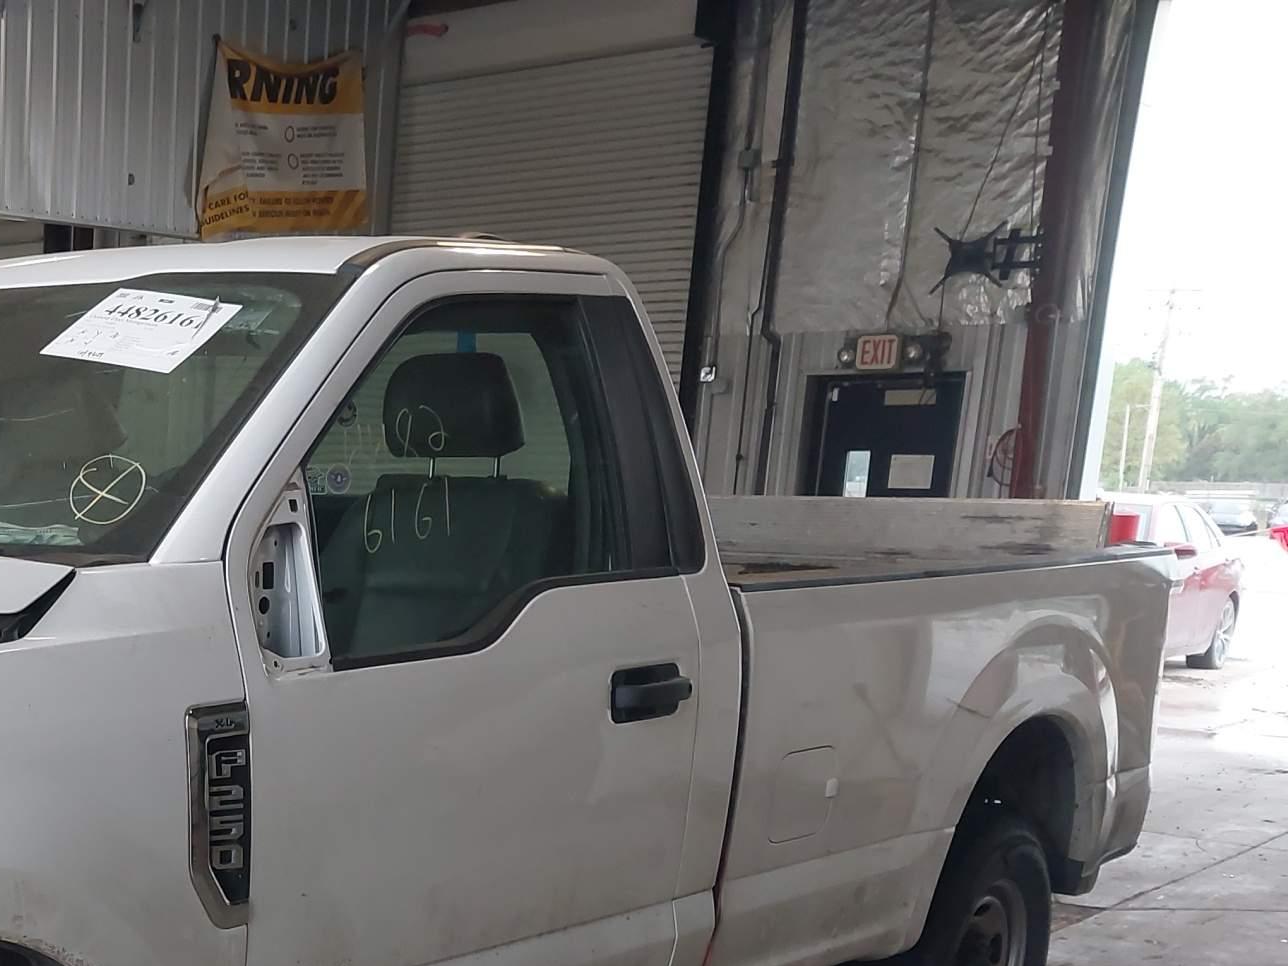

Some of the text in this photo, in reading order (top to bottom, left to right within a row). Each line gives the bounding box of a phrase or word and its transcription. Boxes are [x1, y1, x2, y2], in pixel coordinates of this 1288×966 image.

[202, 205, 250, 227] UIDELINES
[860, 338, 896, 366] EXIT
[363, 476, 450, 553] 6161
